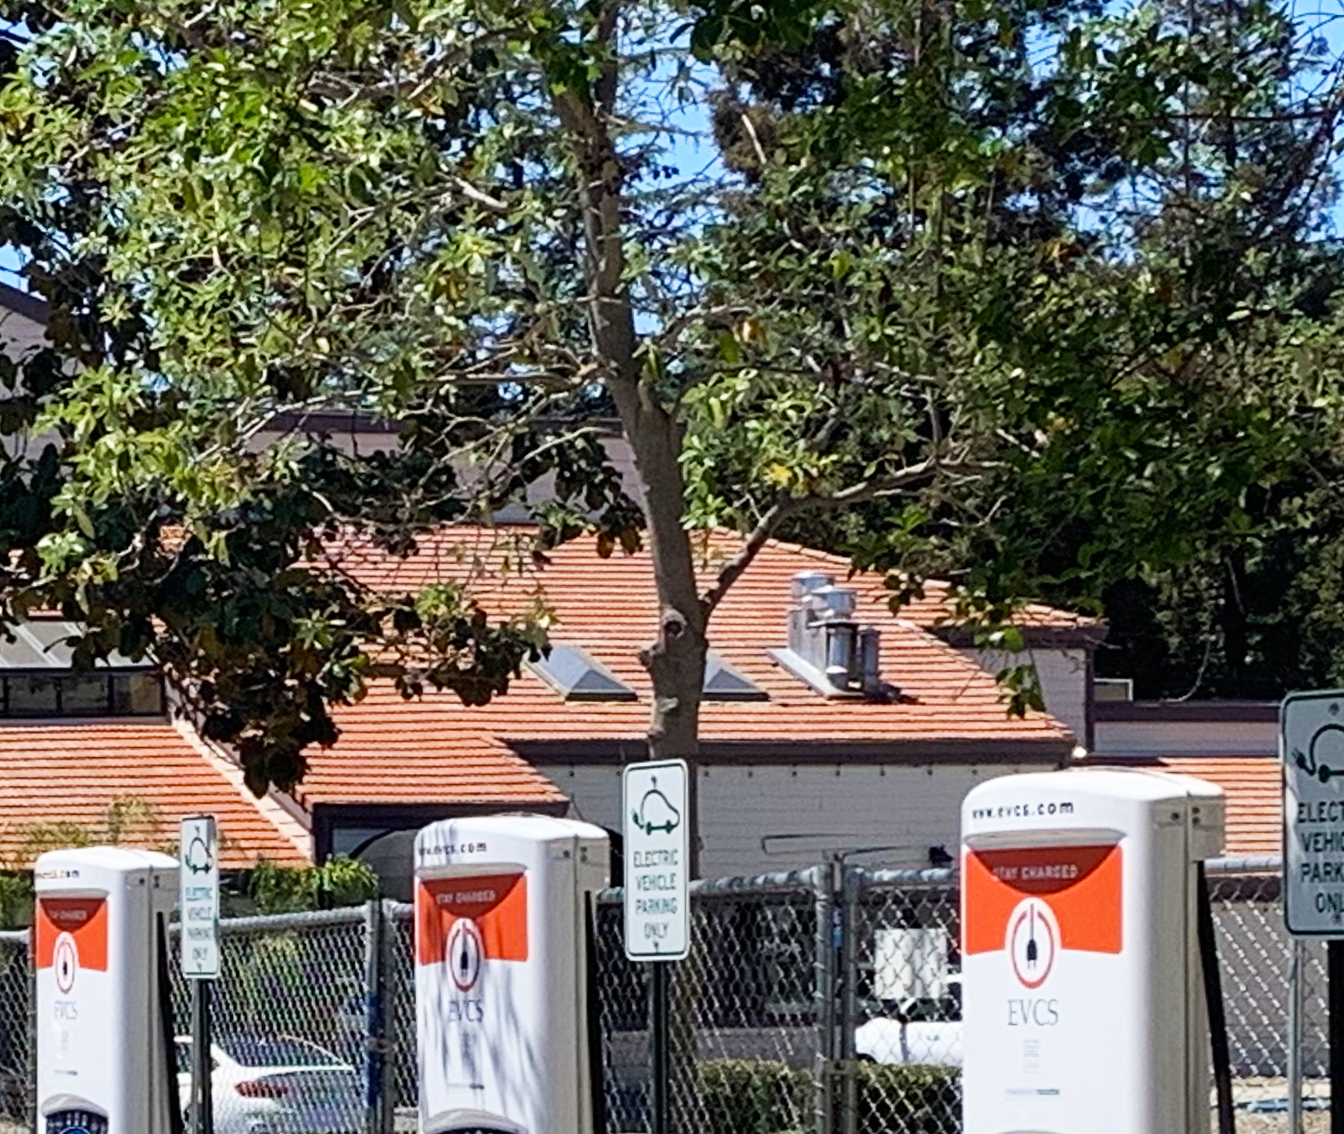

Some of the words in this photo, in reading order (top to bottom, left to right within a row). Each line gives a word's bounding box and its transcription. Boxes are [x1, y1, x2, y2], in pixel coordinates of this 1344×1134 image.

[633, 849, 678, 868] ELECTRIC
[1021, 864, 1078, 880] CHARGED
[635, 873, 677, 891] VEHICLE
[1007, 998, 1059, 1026] EVCS
